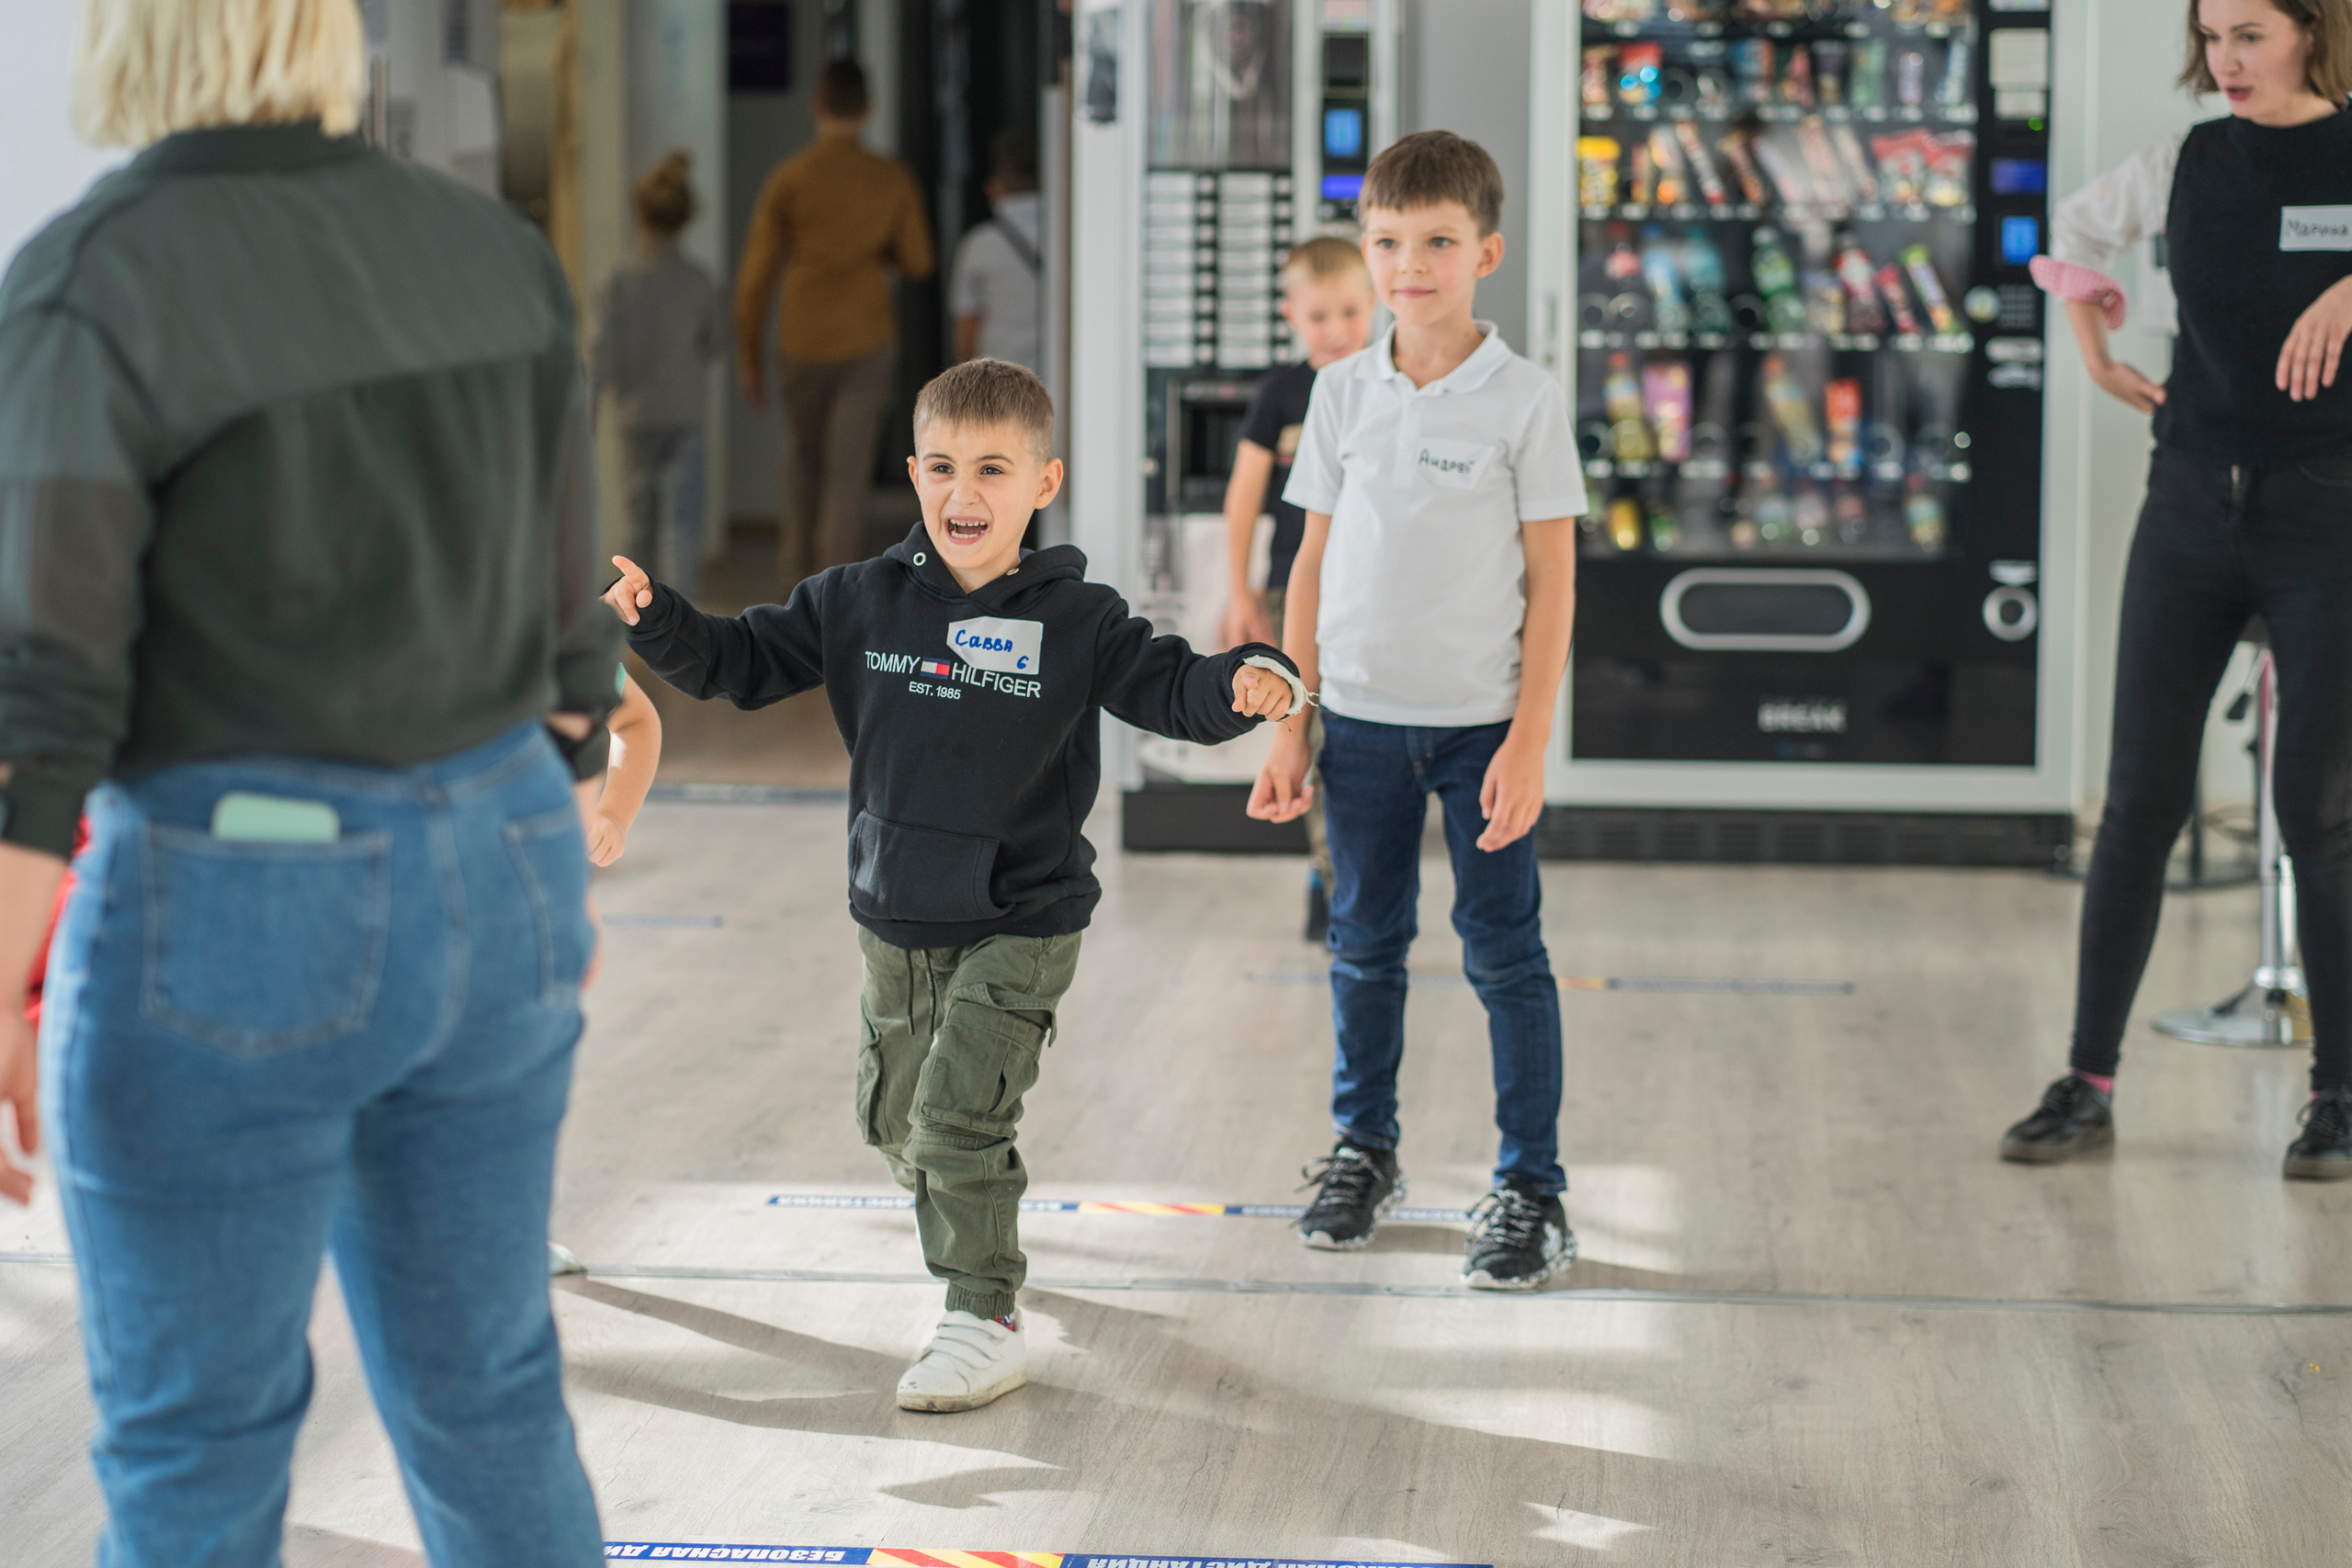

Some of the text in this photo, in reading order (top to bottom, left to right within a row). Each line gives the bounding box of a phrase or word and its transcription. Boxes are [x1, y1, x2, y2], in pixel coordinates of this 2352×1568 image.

[865, 650, 1042, 698] TOMMY HILFIGER
[909, 681, 961, 700] EST. 1985
[649, 1546, 845, 1562] БЕЗОПАСНАЯ
